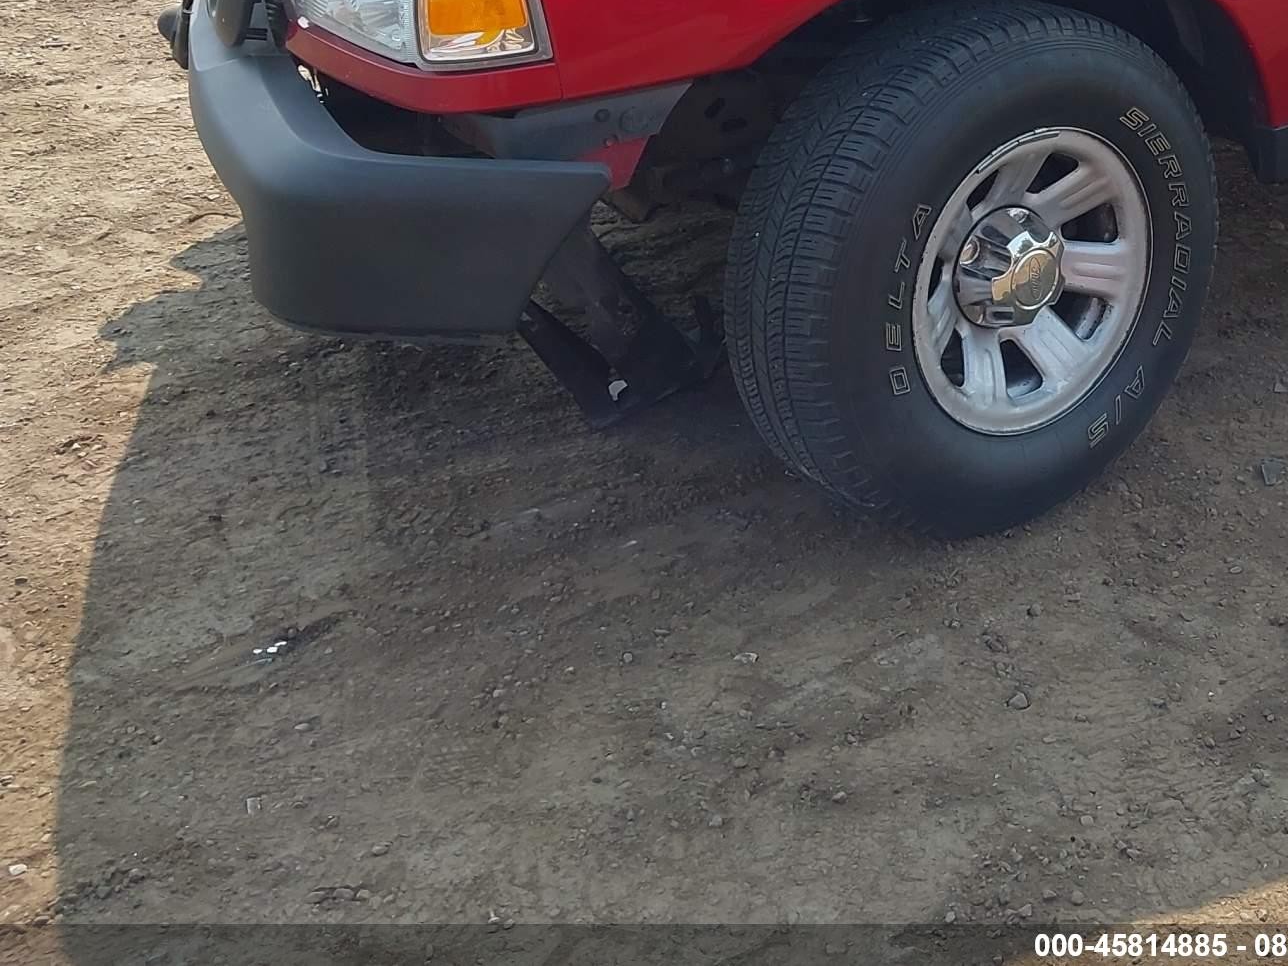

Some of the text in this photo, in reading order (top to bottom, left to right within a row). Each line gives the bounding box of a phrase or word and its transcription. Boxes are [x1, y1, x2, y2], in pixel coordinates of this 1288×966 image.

[885, 203, 933, 395] DELTA
[1087, 106, 1193, 448] SIERRADIAL A/S
